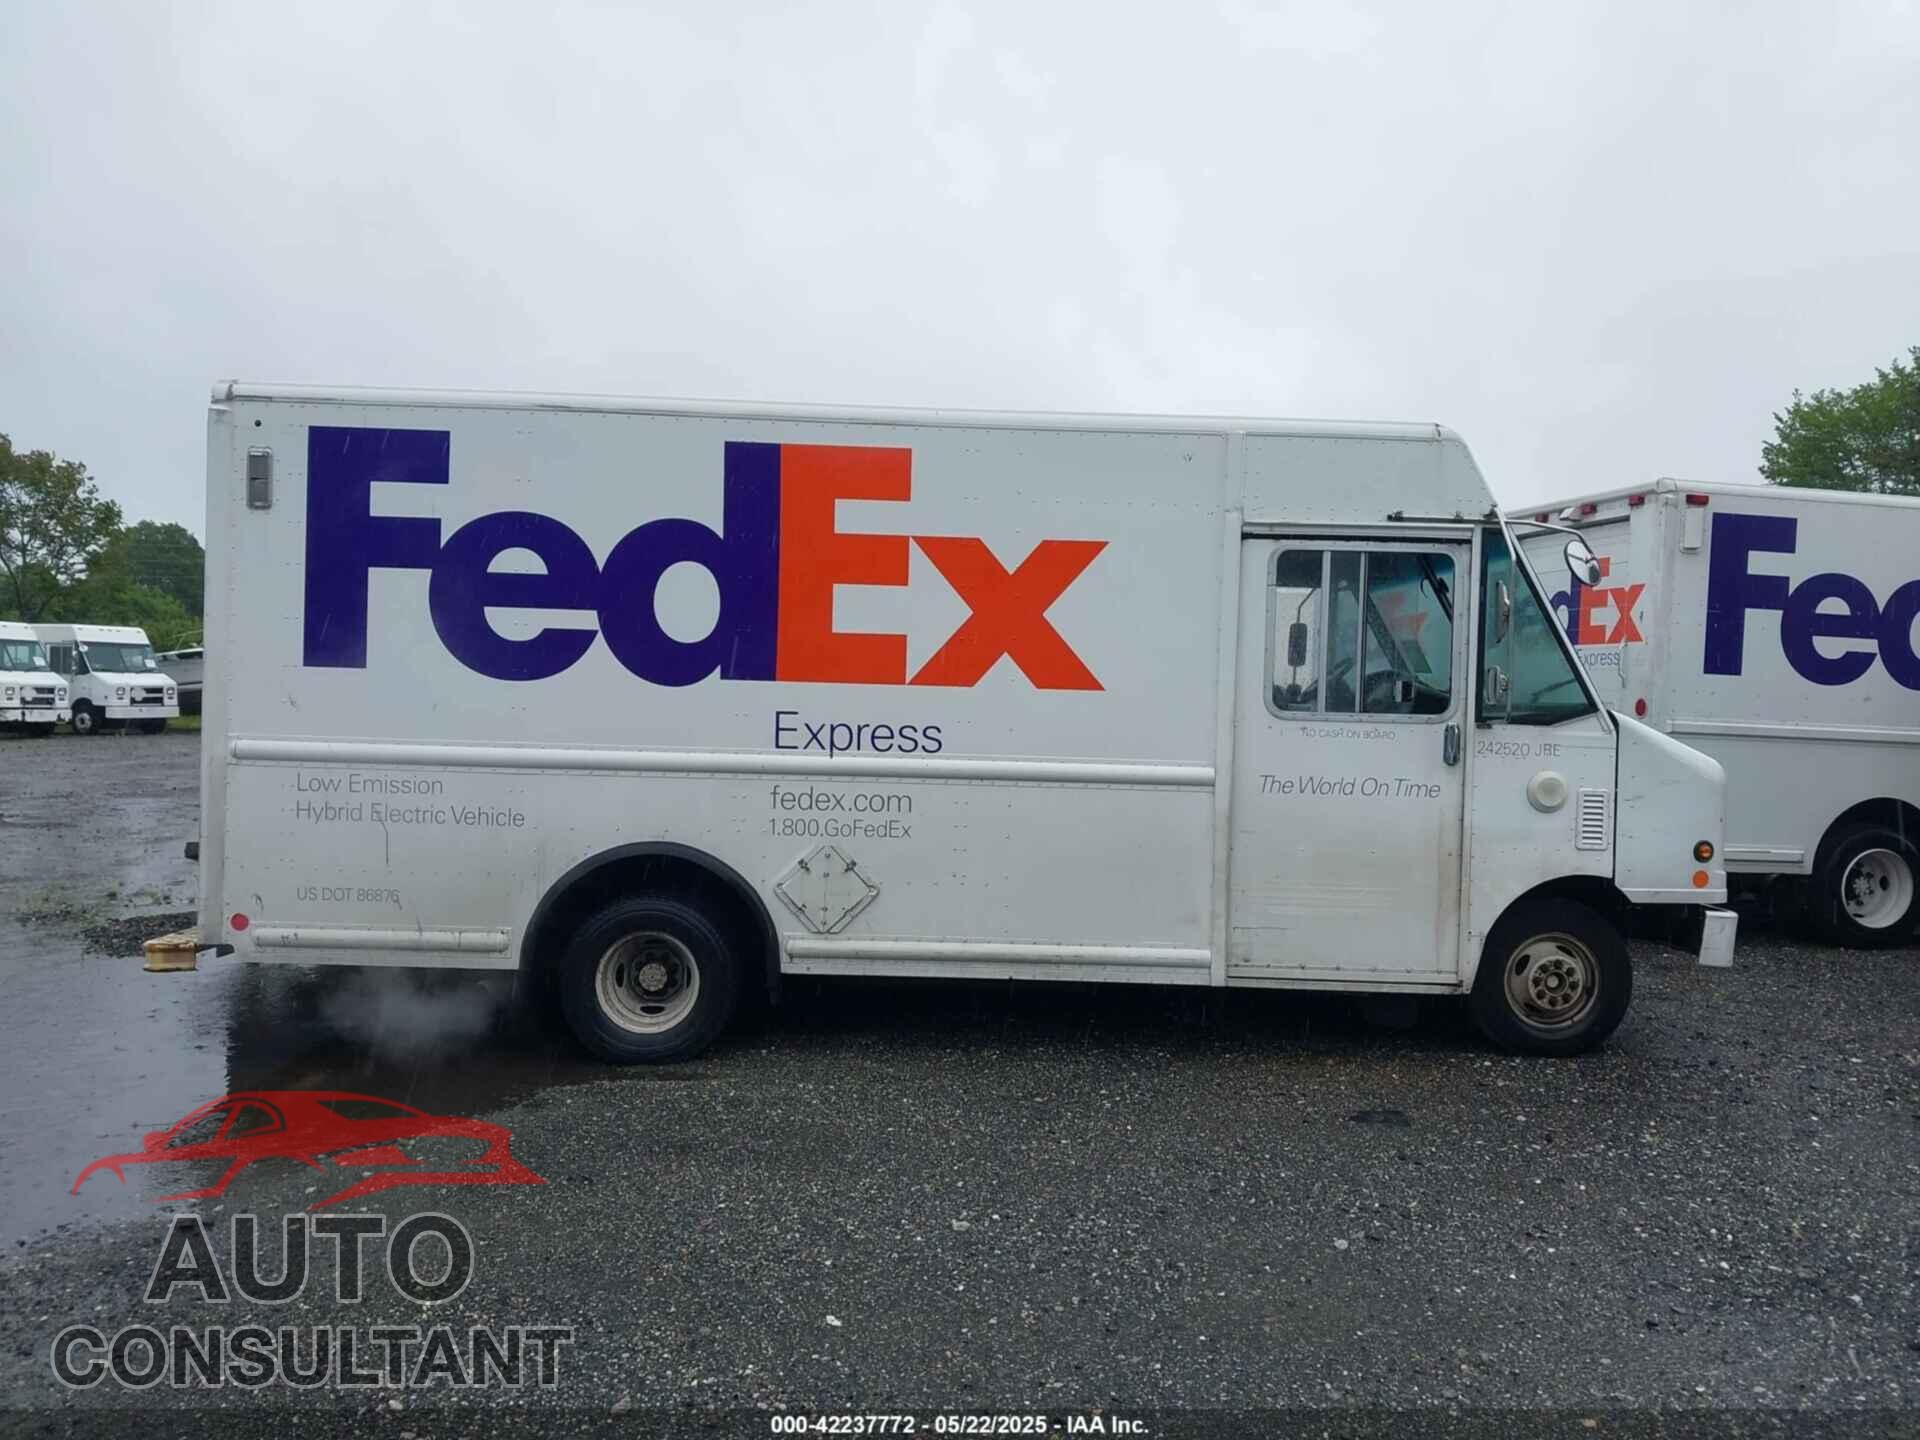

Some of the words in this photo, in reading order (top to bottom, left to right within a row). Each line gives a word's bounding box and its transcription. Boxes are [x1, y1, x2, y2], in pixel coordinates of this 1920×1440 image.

[304, 426, 1109, 691] FedEx
[1550, 556, 1645, 646] dEx
[774, 711, 943, 759] Express
[1477, 740, 1530, 756] 242520
[296, 772, 341, 792] Low
[349, 774, 443, 795] Emission
[1260, 775, 1294, 795] The
[1299, 776, 1354, 796] World
[1361, 778, 1389, 797] On
[1394, 779, 1441, 799] Time
[770, 785, 912, 813] fedex.com
[296, 801, 363, 825] Hybrid
[370, 803, 446, 825] Electric
[450, 806, 525, 827] Vehicle
[770, 818, 912, 839] 1.800.GoFedEx
[296, 887, 317, 901] US
[321, 887, 353, 901] DOT
